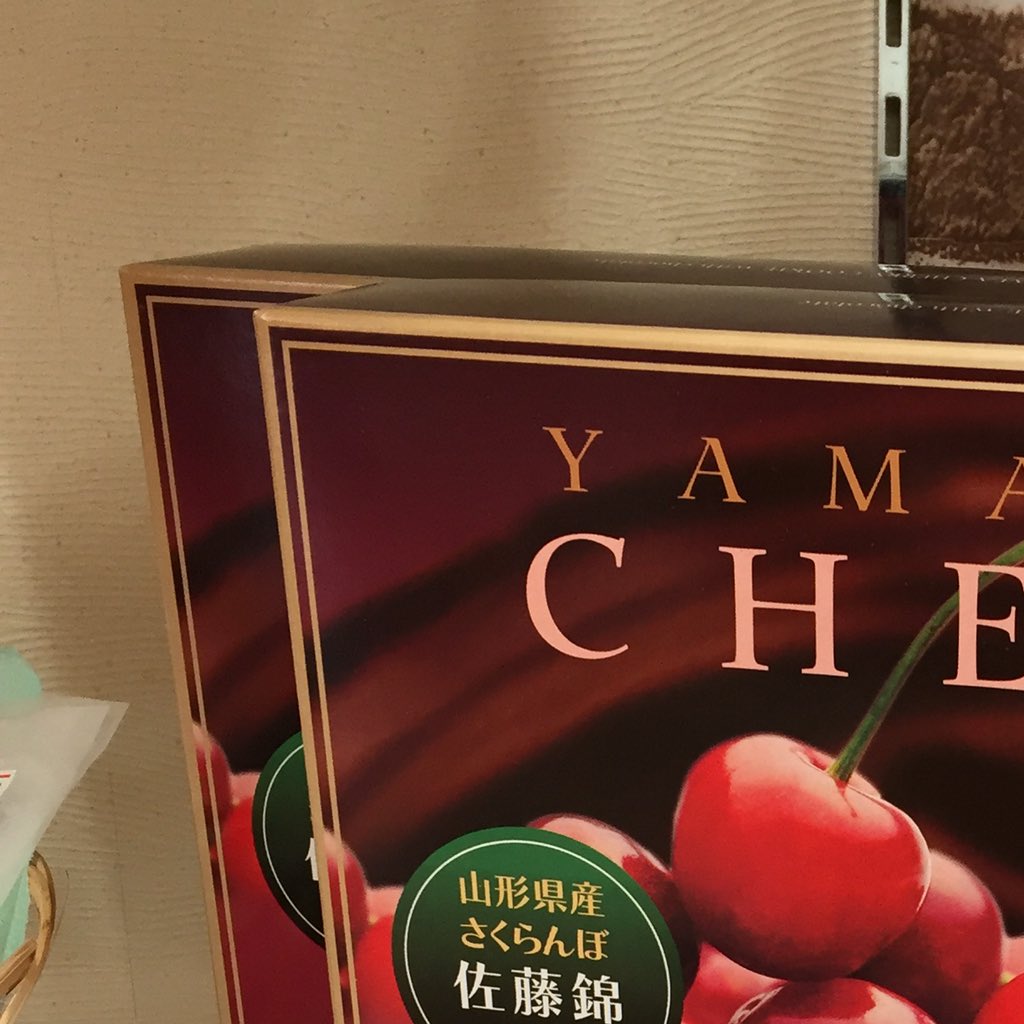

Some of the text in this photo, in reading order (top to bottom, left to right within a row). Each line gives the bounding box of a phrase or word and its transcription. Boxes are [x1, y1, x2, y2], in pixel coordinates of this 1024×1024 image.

[459, 870, 606, 917] 山形県産
[460, 916, 610, 961] さくらんぼ
